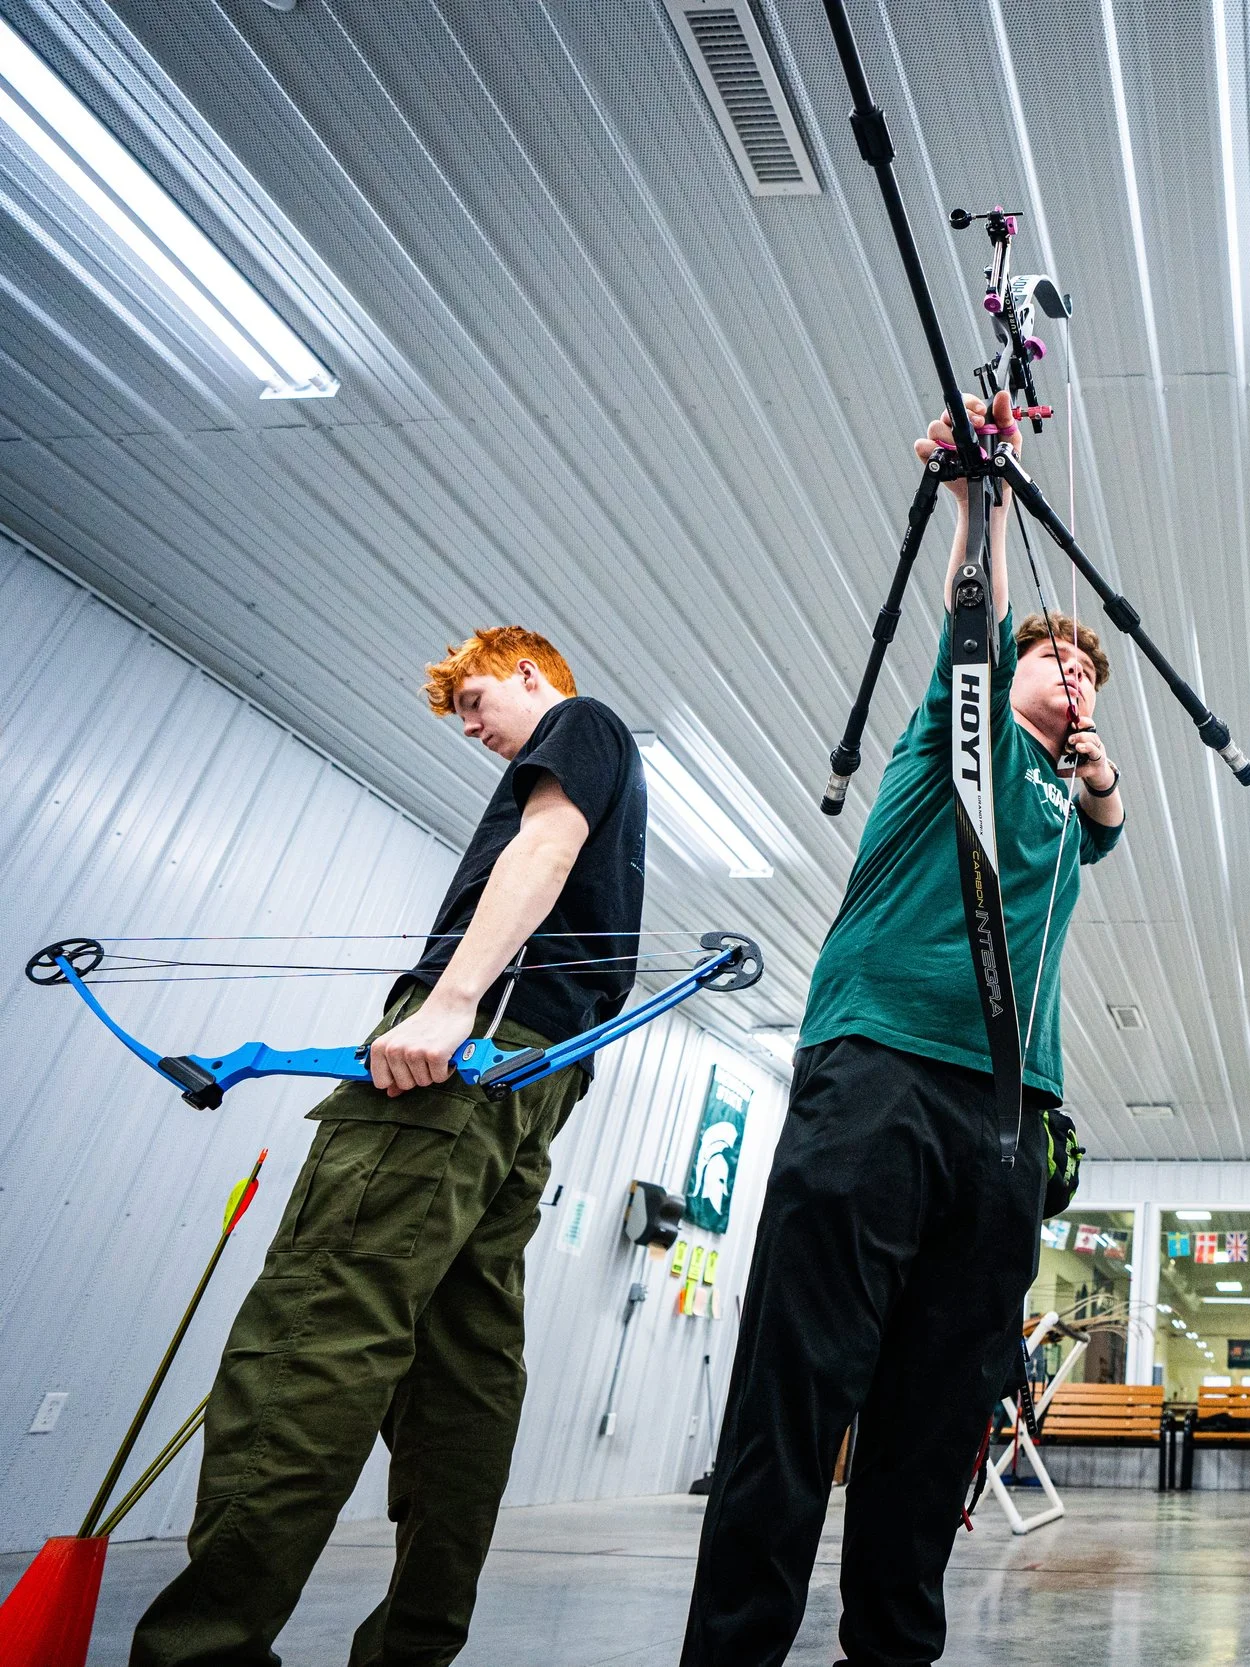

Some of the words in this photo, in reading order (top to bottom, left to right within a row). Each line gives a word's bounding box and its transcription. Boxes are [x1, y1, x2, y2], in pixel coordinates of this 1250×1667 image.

[960, 673, 982, 792] HOYT
[972, 850, 984, 909] CARBON
[975, 909, 1004, 1018] INTEGRA
